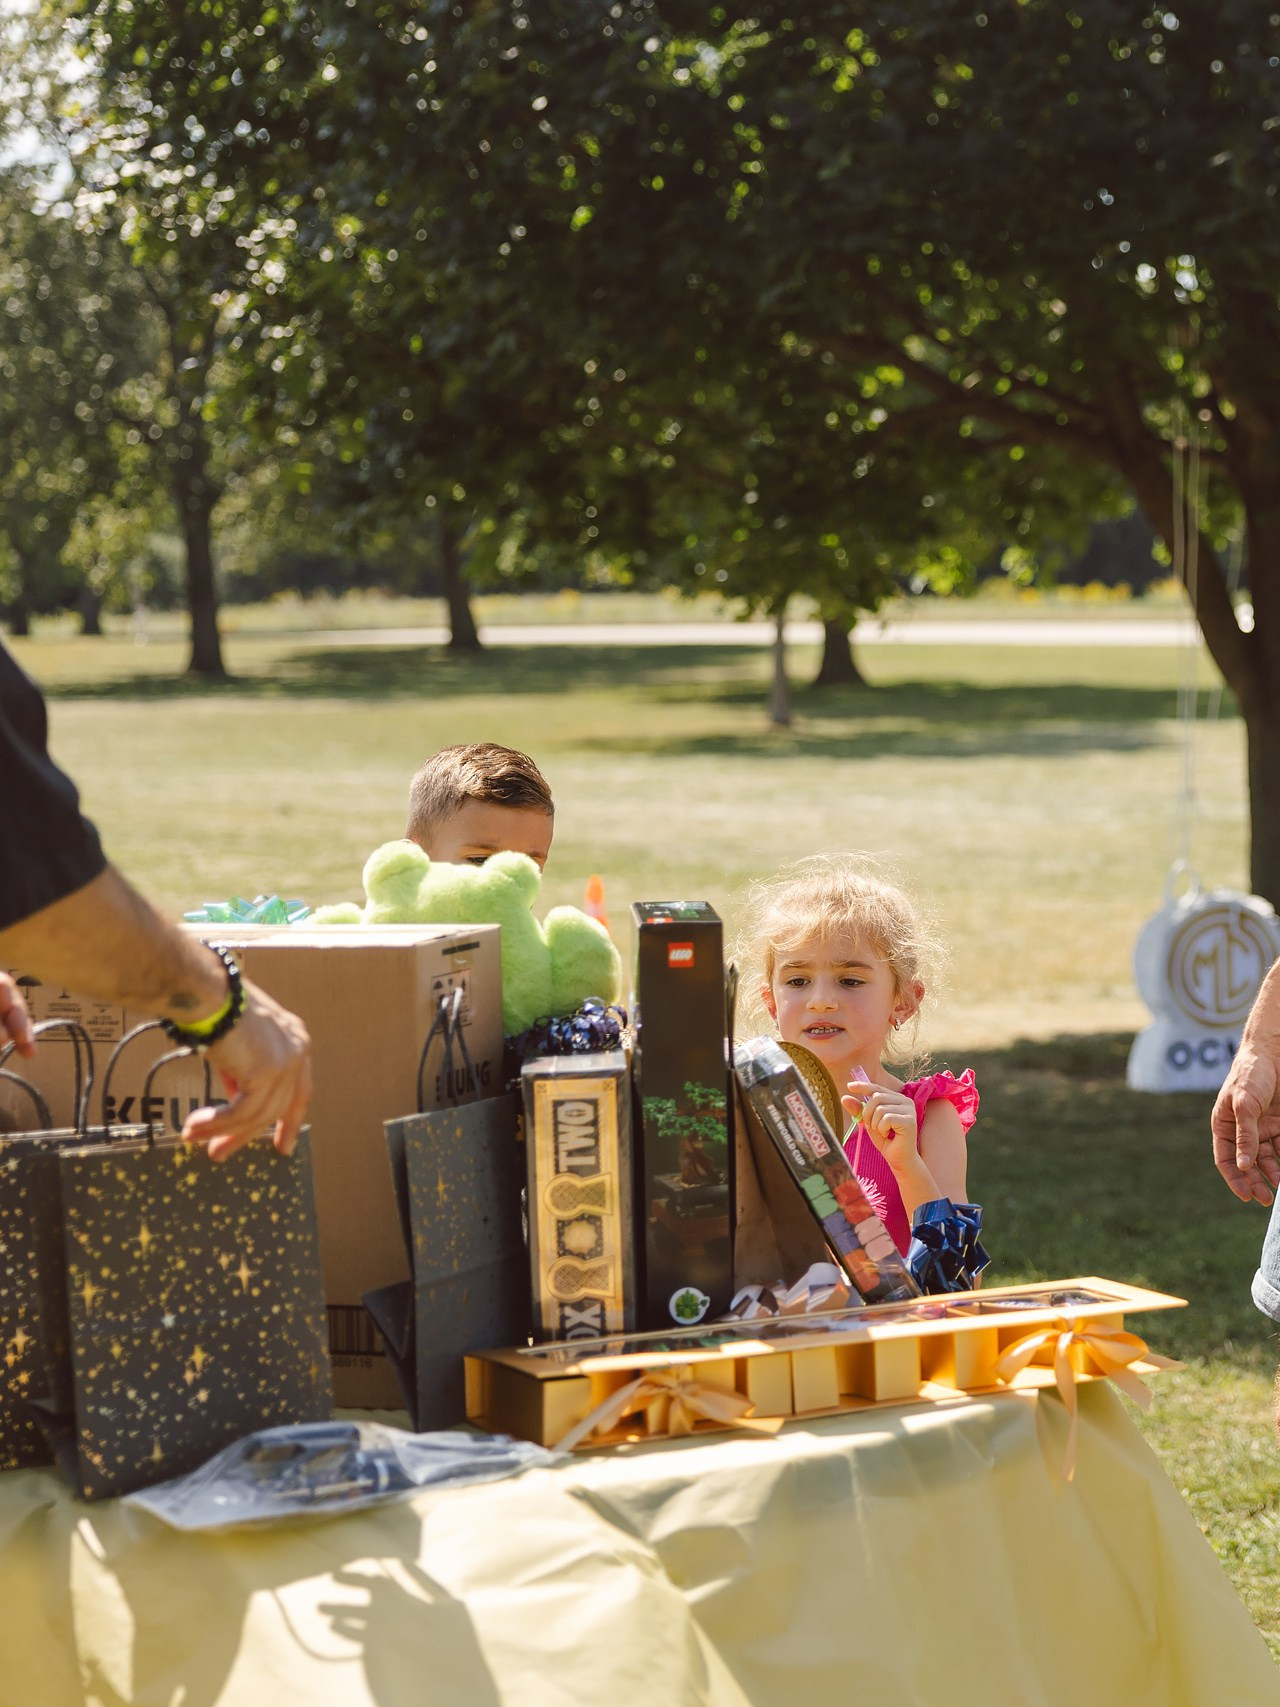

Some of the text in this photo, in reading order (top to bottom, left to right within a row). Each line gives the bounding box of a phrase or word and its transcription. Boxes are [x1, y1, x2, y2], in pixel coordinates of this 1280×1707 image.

[669, 948, 693, 962] LEGO
[557, 1101, 596, 1173] TWO
[767, 1104, 781, 1123] FIFA
[776, 1121, 796, 1150] WORLD
[792, 1148, 806, 1166] CUP
[789, 1094, 828, 1154] MONOPOLY
